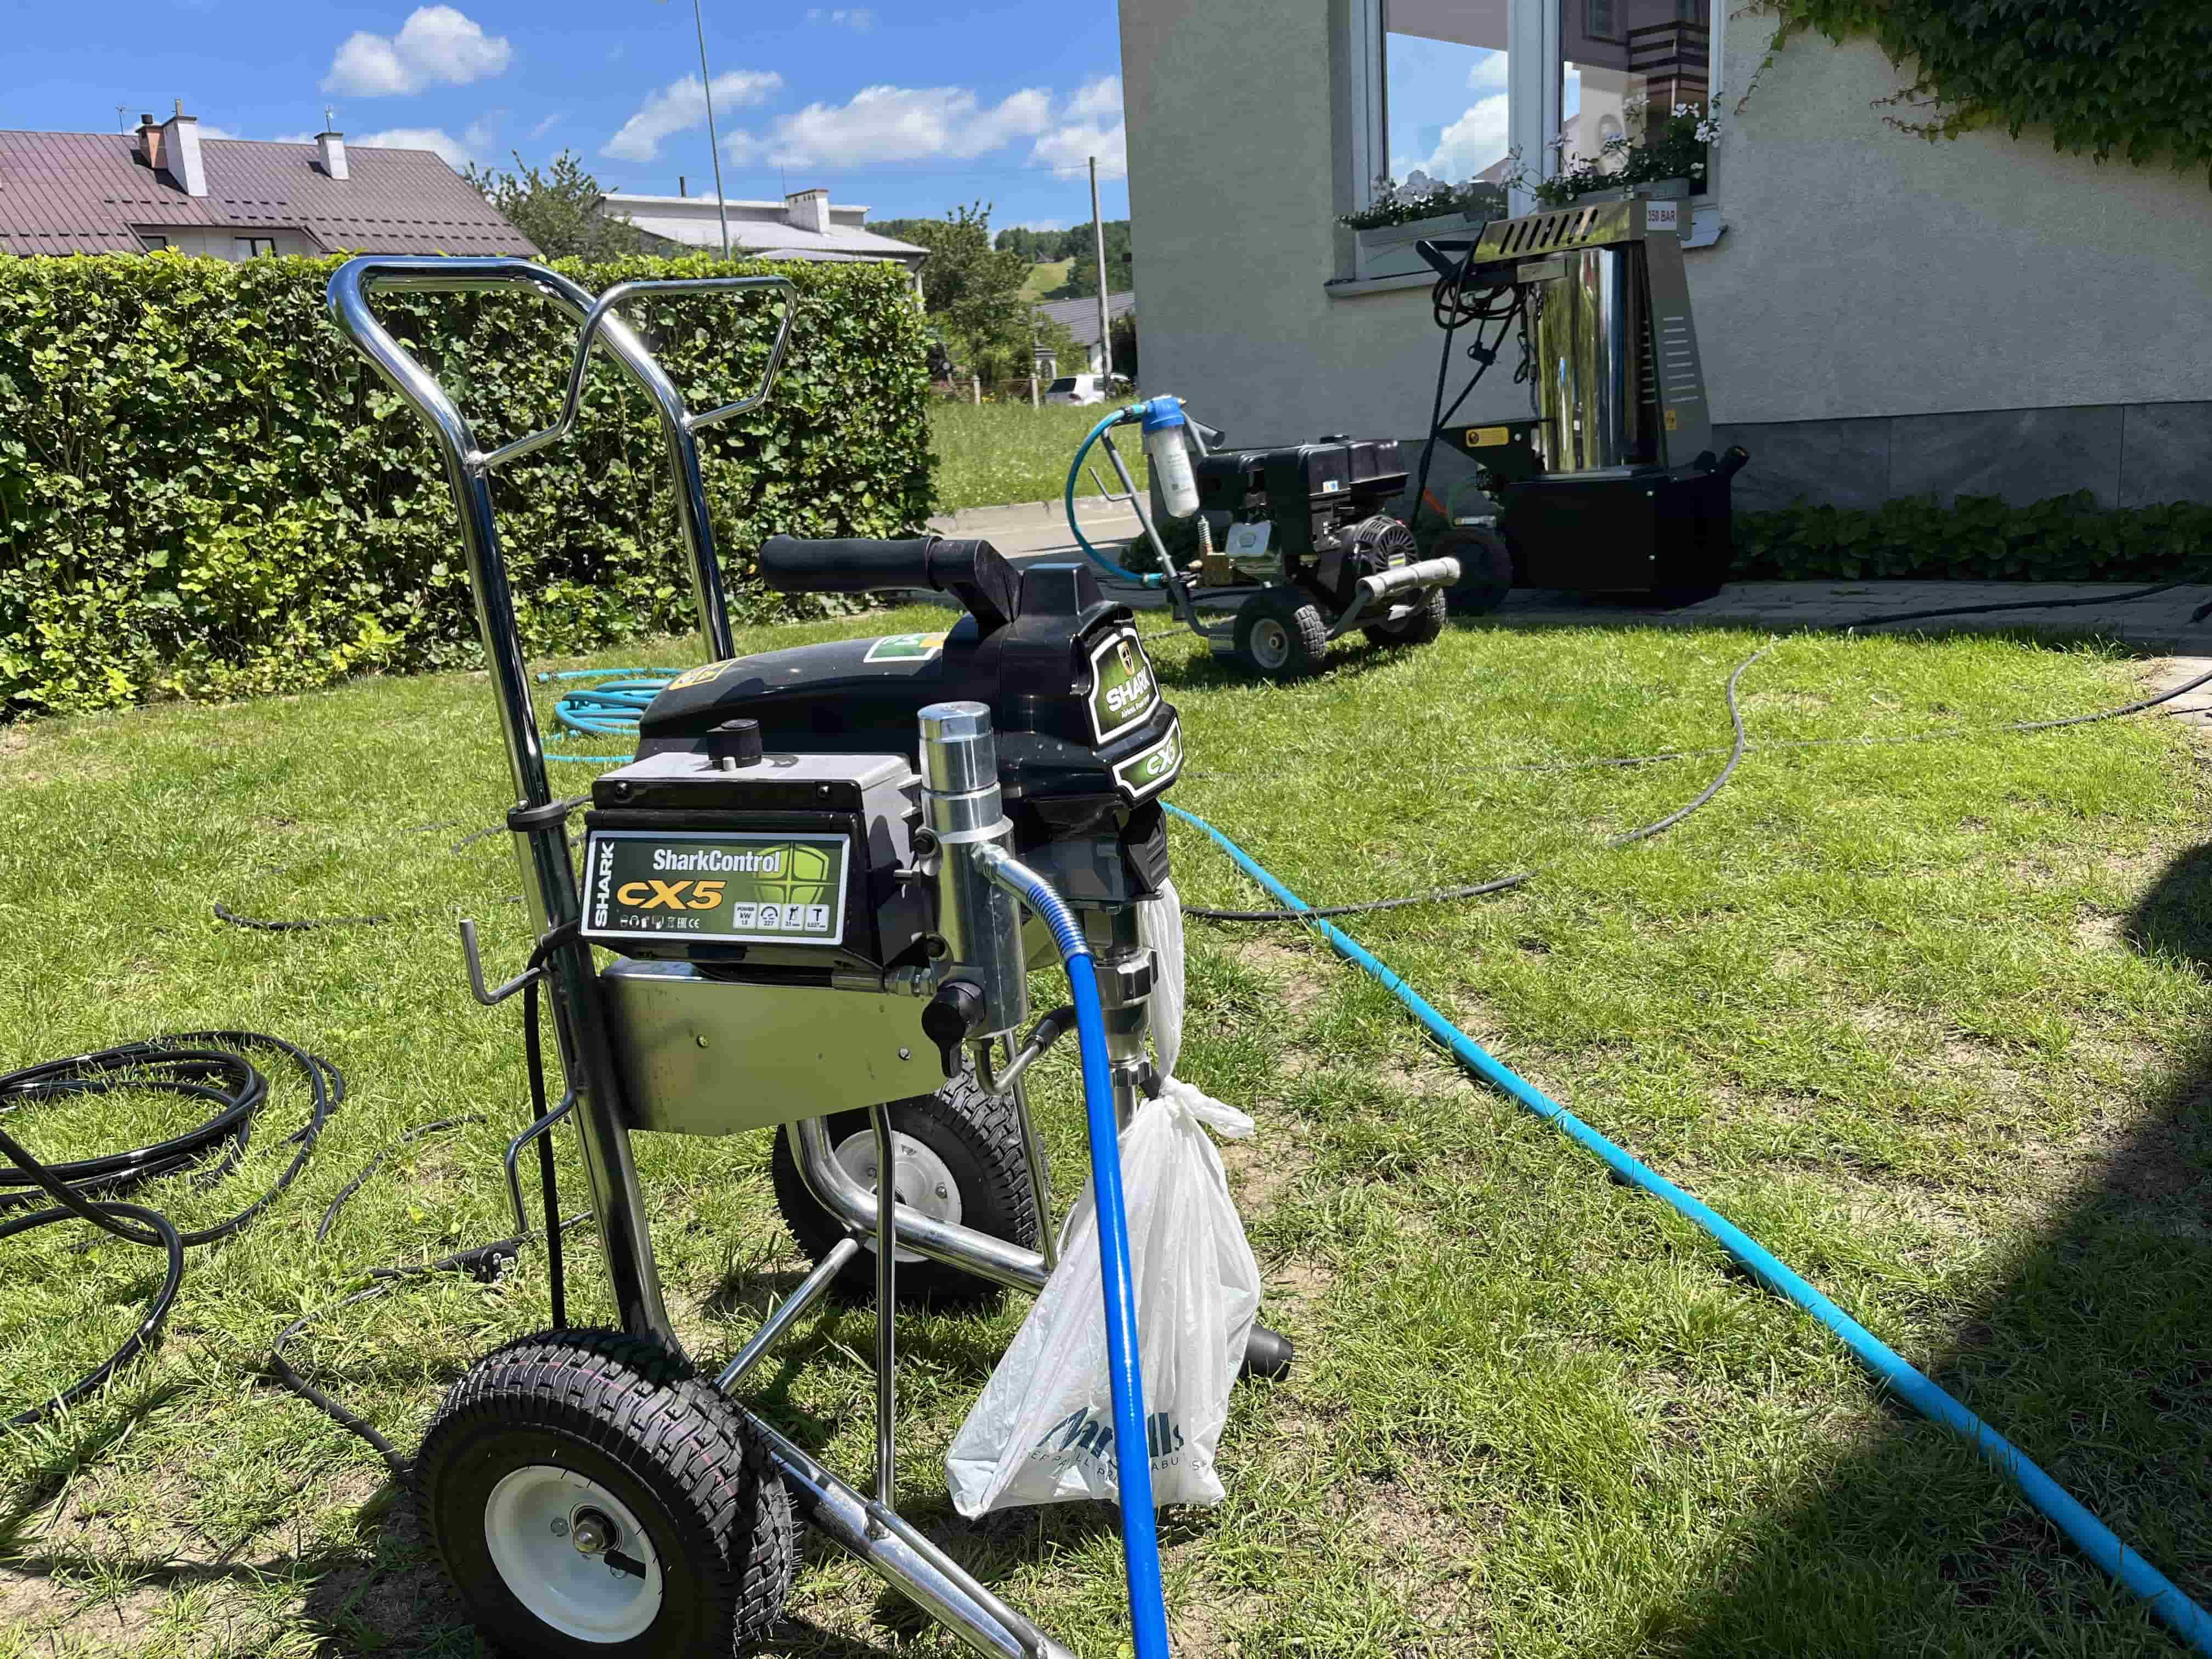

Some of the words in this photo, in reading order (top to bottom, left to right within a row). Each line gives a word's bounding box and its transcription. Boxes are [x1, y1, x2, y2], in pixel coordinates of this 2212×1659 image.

[1661, 210, 1677, 222] BAR
[1106, 667, 1150, 712] SHARK
[653, 848, 781, 873] SharkControl
[594, 841, 615, 928] SHARK
